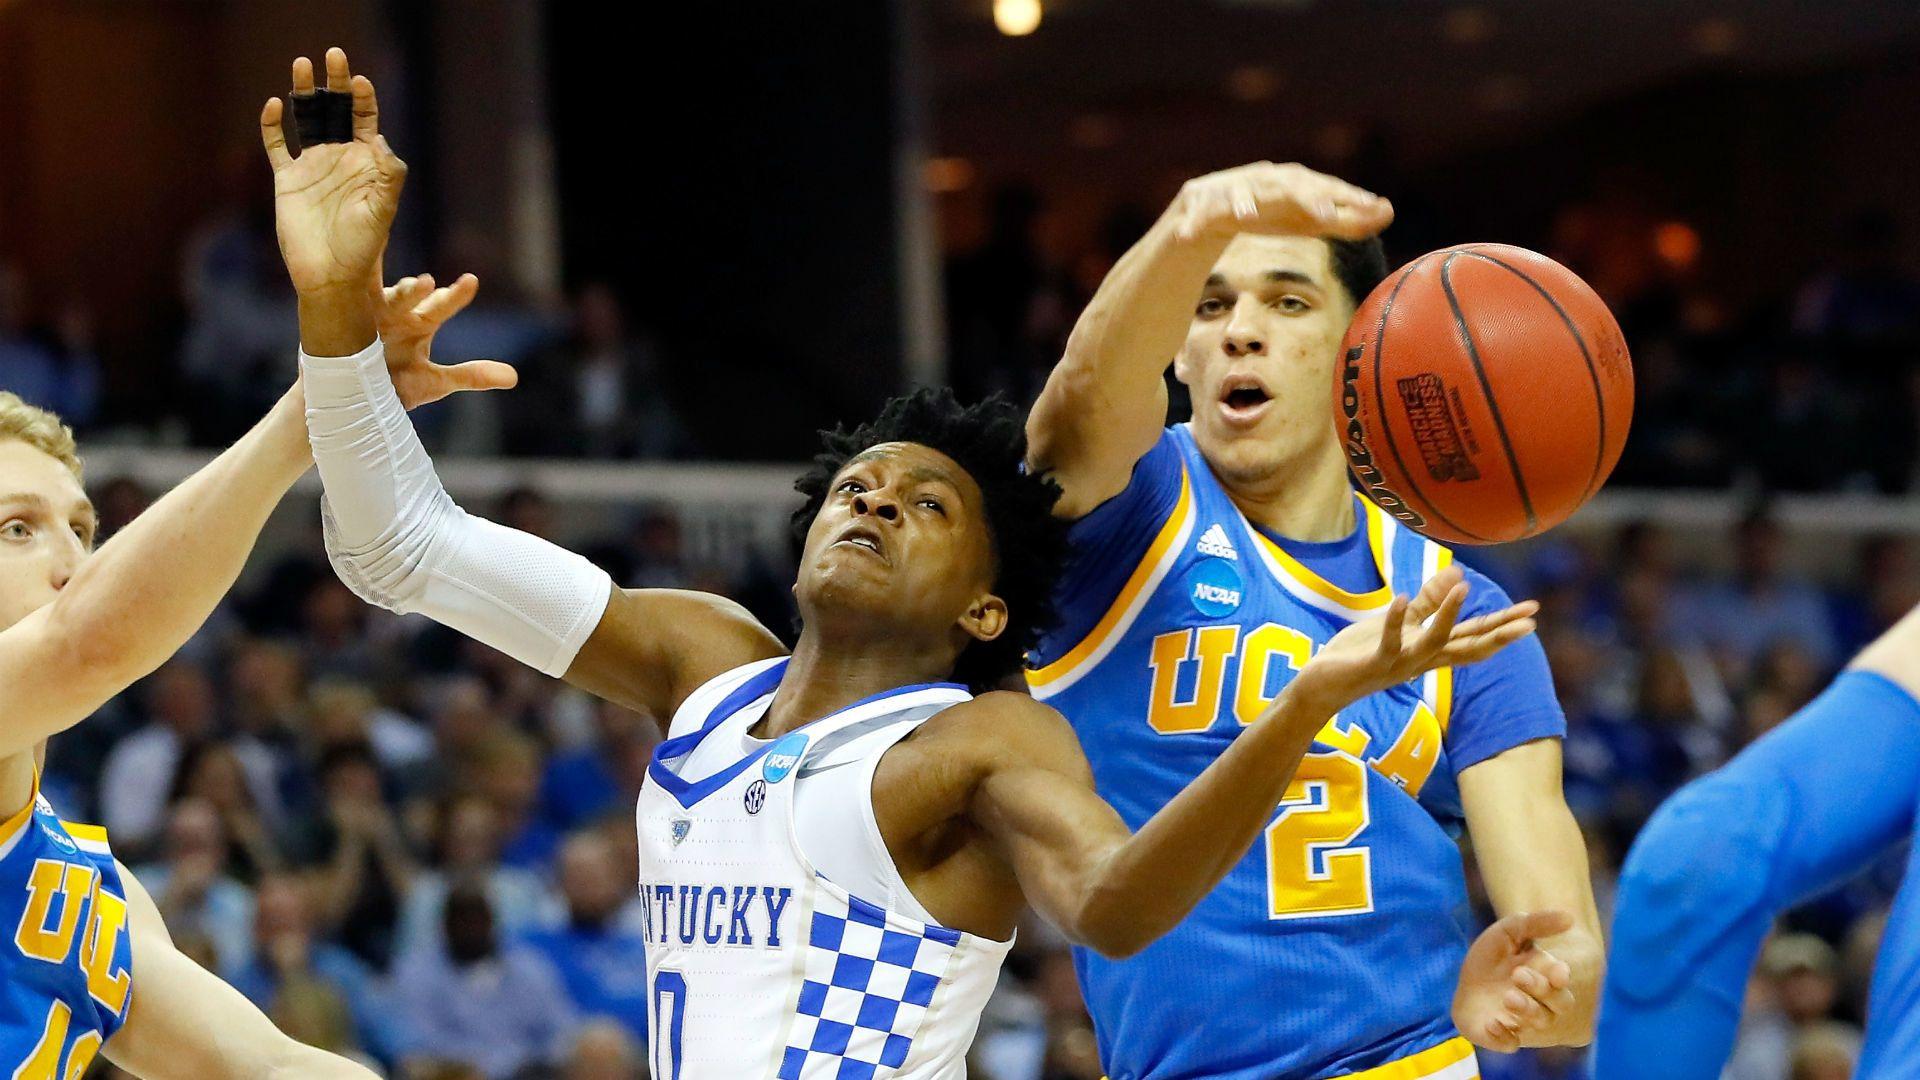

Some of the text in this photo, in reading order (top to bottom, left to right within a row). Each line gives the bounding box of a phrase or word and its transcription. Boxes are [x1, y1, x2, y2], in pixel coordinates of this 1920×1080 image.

[1343, 344, 1426, 527] Wilson
[1196, 541, 1238, 561] adidas
[1194, 582, 1240, 607] NCAA
[766, 754, 800, 769] NCAA
[1265, 750, 1374, 920] 2
